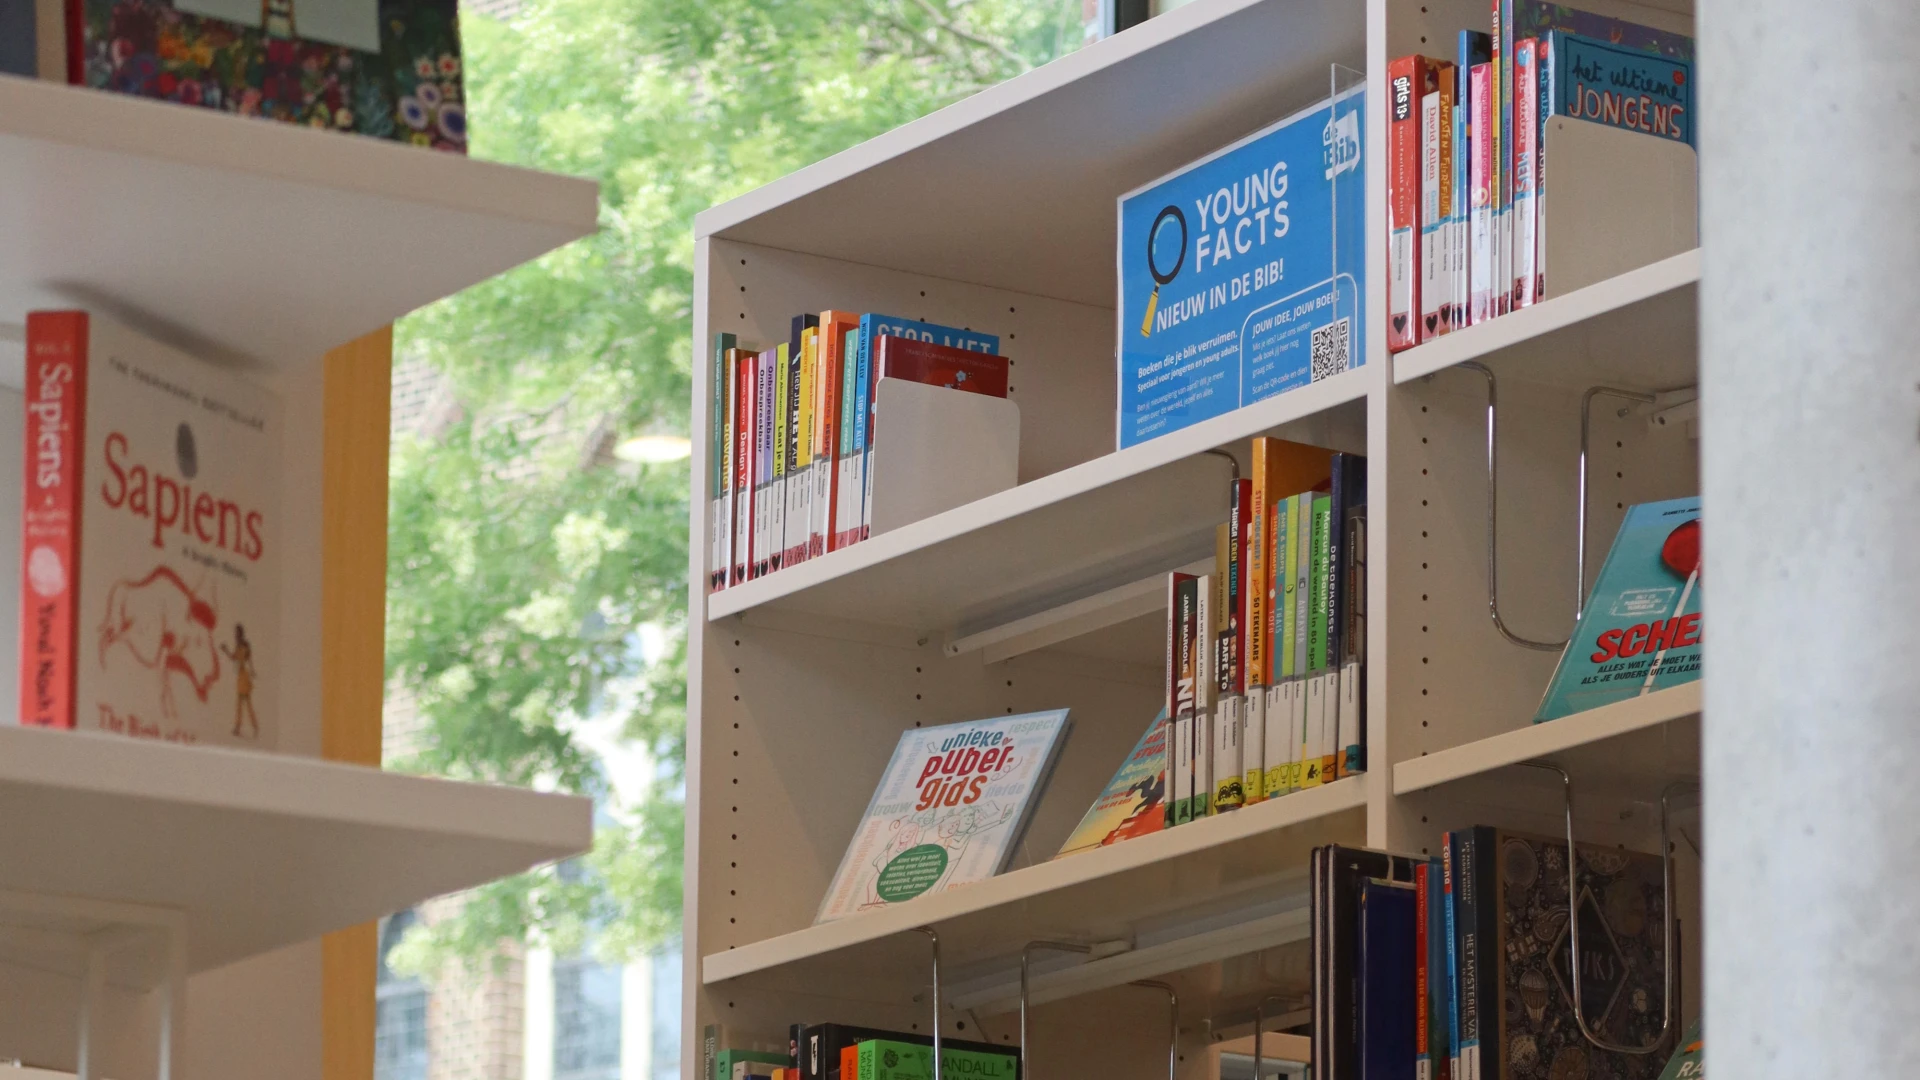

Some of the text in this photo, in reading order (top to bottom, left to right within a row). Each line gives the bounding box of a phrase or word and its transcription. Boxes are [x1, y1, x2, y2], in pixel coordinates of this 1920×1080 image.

[1394, 77, 1410, 103] girls
[1573, 54, 1682, 103] het ultieme
[1569, 82, 1684, 139] JONGENS
[1195, 161, 1288, 232] YOUNG
[1196, 200, 1290, 273] FACTS
[1156, 257, 1284, 333] NIEUW IN DE BIB!
[1252, 301, 1314, 339] JOUW IDEE, JOUW
[944, 335, 992, 354] MET
[1138, 330, 1238, 378] Boeken die je blik verruimen.
[1137, 343, 1240, 394] Speciaal voor jongeren en young adults.
[29, 363, 73, 489] Sapiens
[766, 366, 774, 450] Onbespreekbaar
[776, 450, 782, 462] je
[101, 431, 264, 562] Sapiens
[1230, 507, 1239, 538] MANGA
[1230, 538, 1238, 561] LEREN
[1312, 559, 1320, 572] de
[1314, 538, 1320, 556] om
[1319, 510, 1330, 614] Marcus du Sautoy
[1330, 546, 1336, 562] De
[1311, 576, 1319, 614] wereld
[1328, 564, 1336, 634] toekomst
[1252, 597, 1260, 660] 50 TEKENAARS
[1310, 630, 1317, 644] 80
[1311, 616, 1318, 627] in
[1590, 612, 1704, 664] SCHE
[1222, 673, 1228, 690] TO
[1581, 676, 1598, 685] ALS
[1600, 674, 1611, 683] JE
[1614, 670, 1648, 681] OUDERS
[1650, 668, 1664, 677] UIT
[1598, 656, 1686, 674] ALLES WAT JE MOET
[941, 728, 1004, 752] unieke
[1008, 718, 1058, 735] respect
[873, 801, 913, 817] trouw
[916, 775, 988, 812] gids
[1443, 845, 1451, 885] corona
[1418, 967, 1424, 976] DE
[1466, 934, 1476, 1041] HET MYSTERIE VAN
[940, 1056, 1000, 1077] ANDALL
